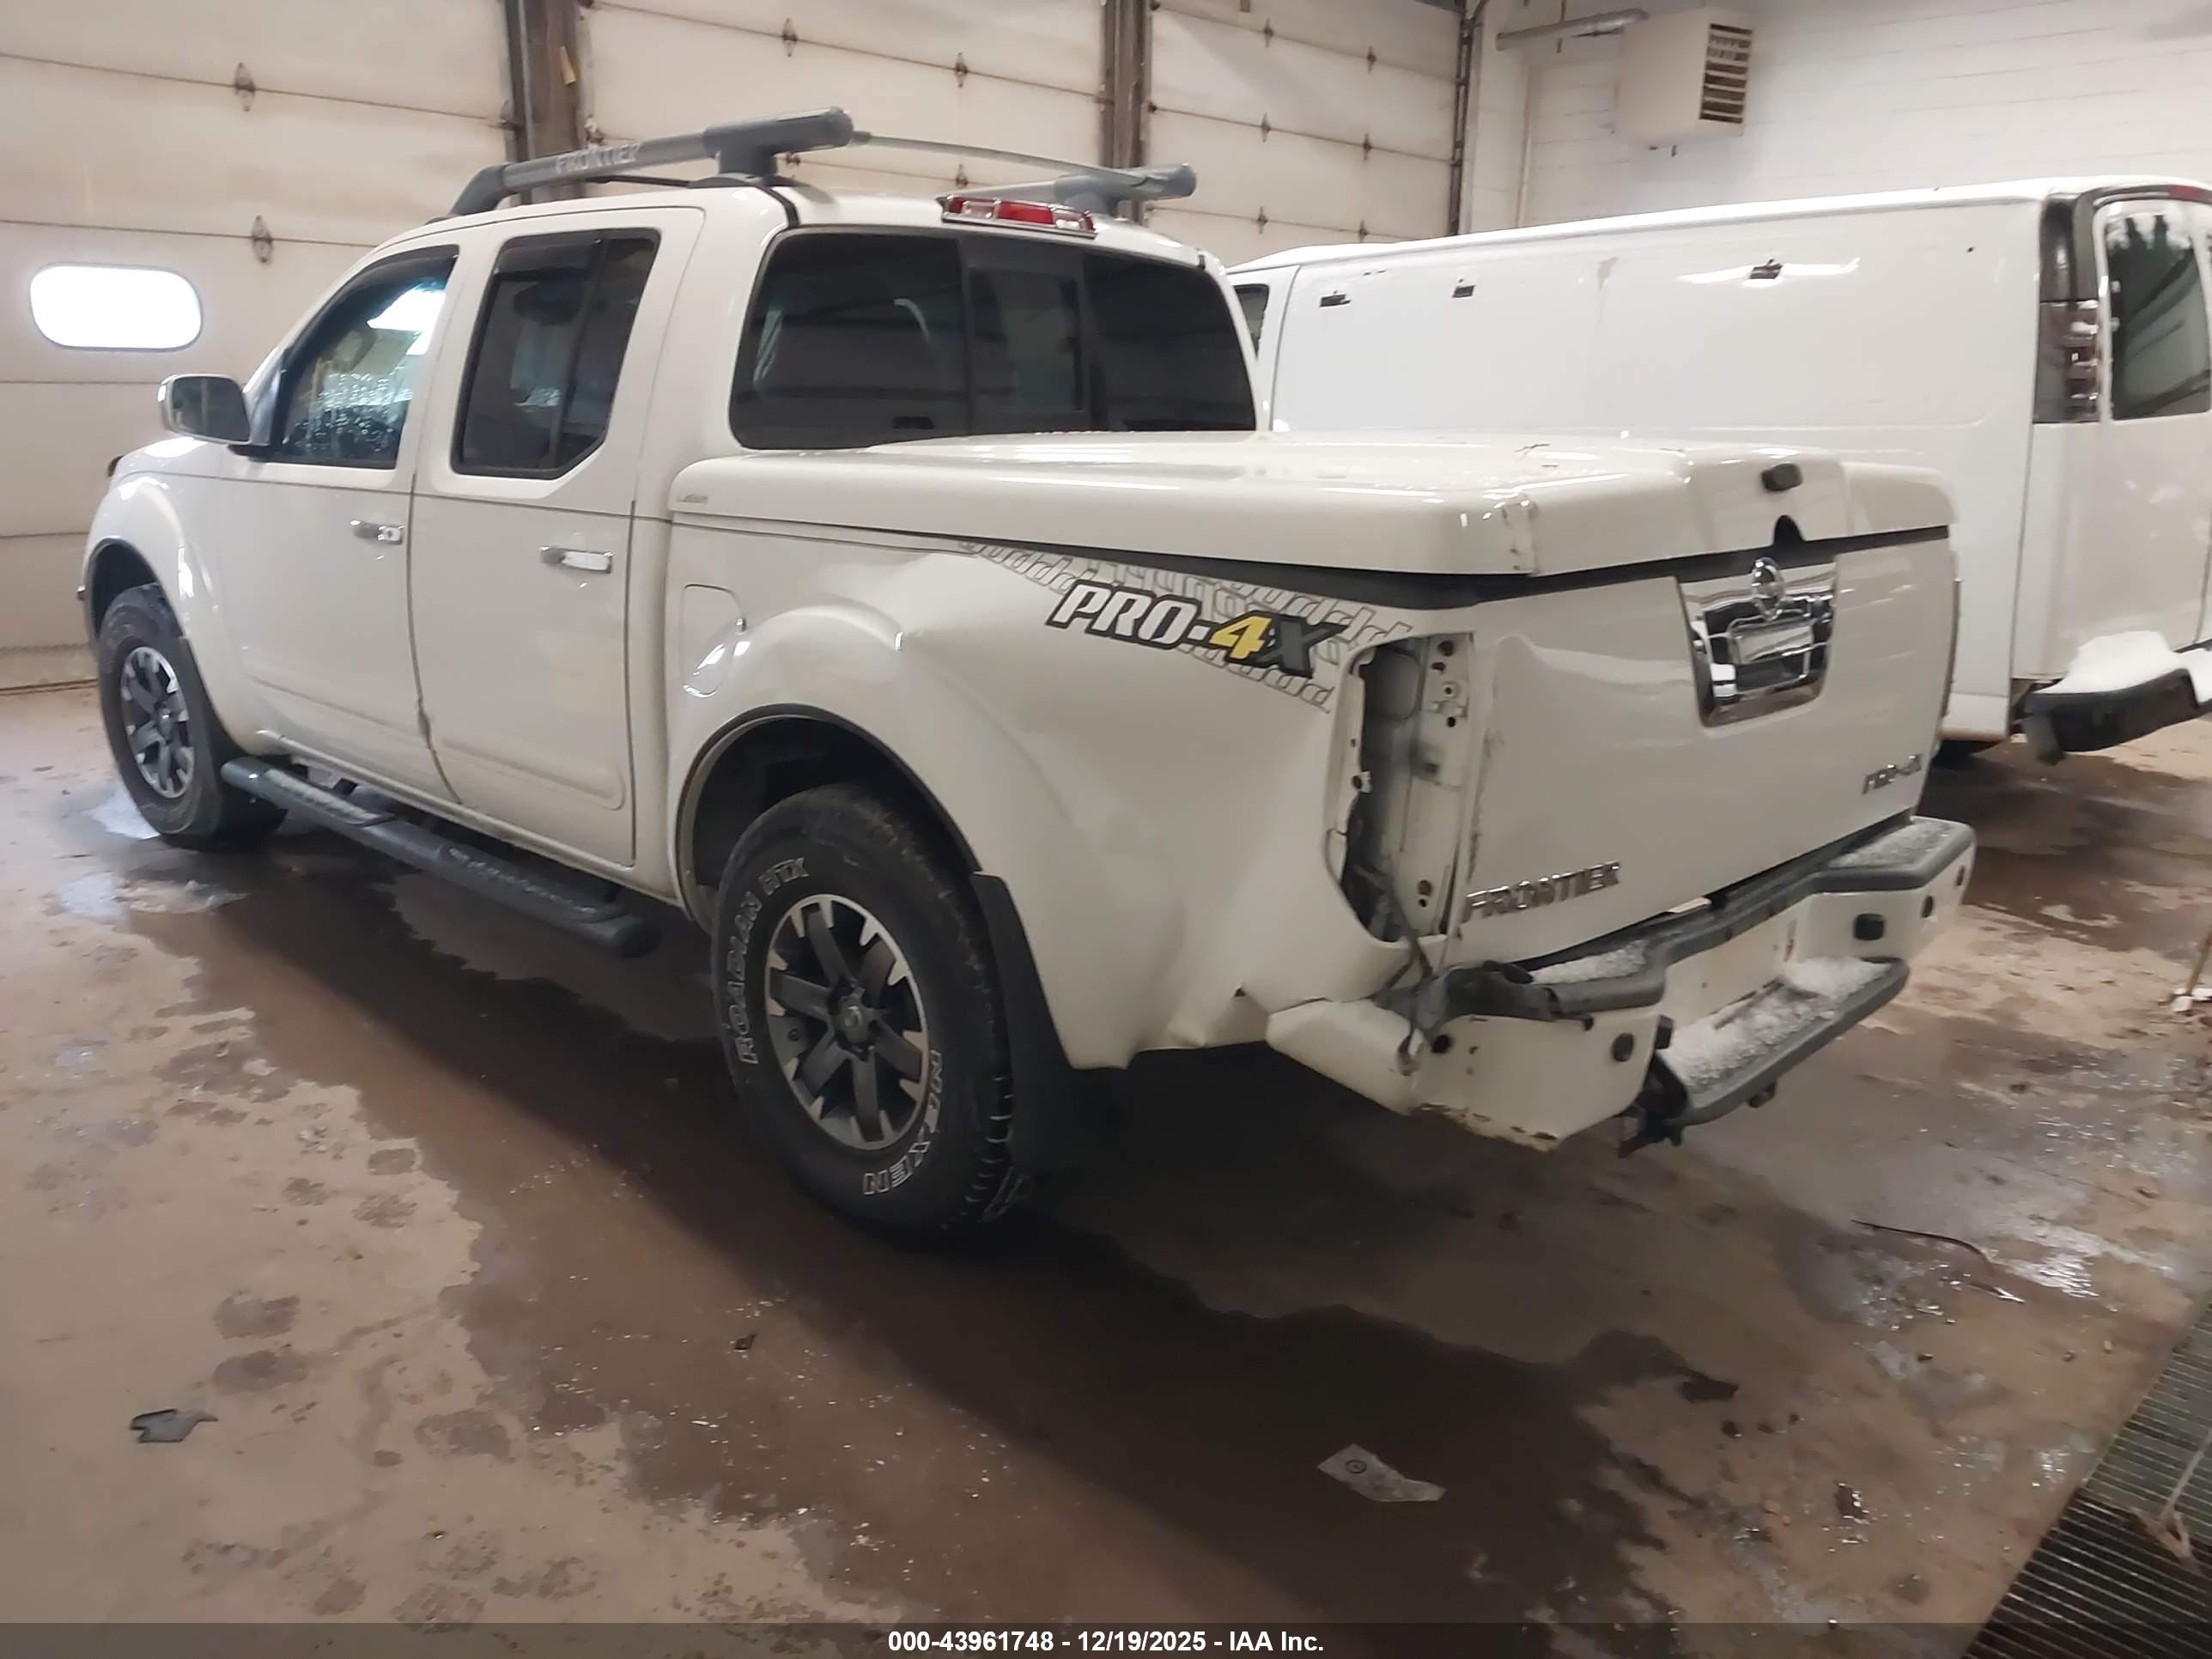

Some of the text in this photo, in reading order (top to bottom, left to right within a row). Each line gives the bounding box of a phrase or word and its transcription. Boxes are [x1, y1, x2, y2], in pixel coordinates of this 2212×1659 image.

[554, 142, 642, 174] FRONTIER
[1045, 579, 1350, 678] PRO-4X
[1461, 860, 1620, 924] FRONTIER
